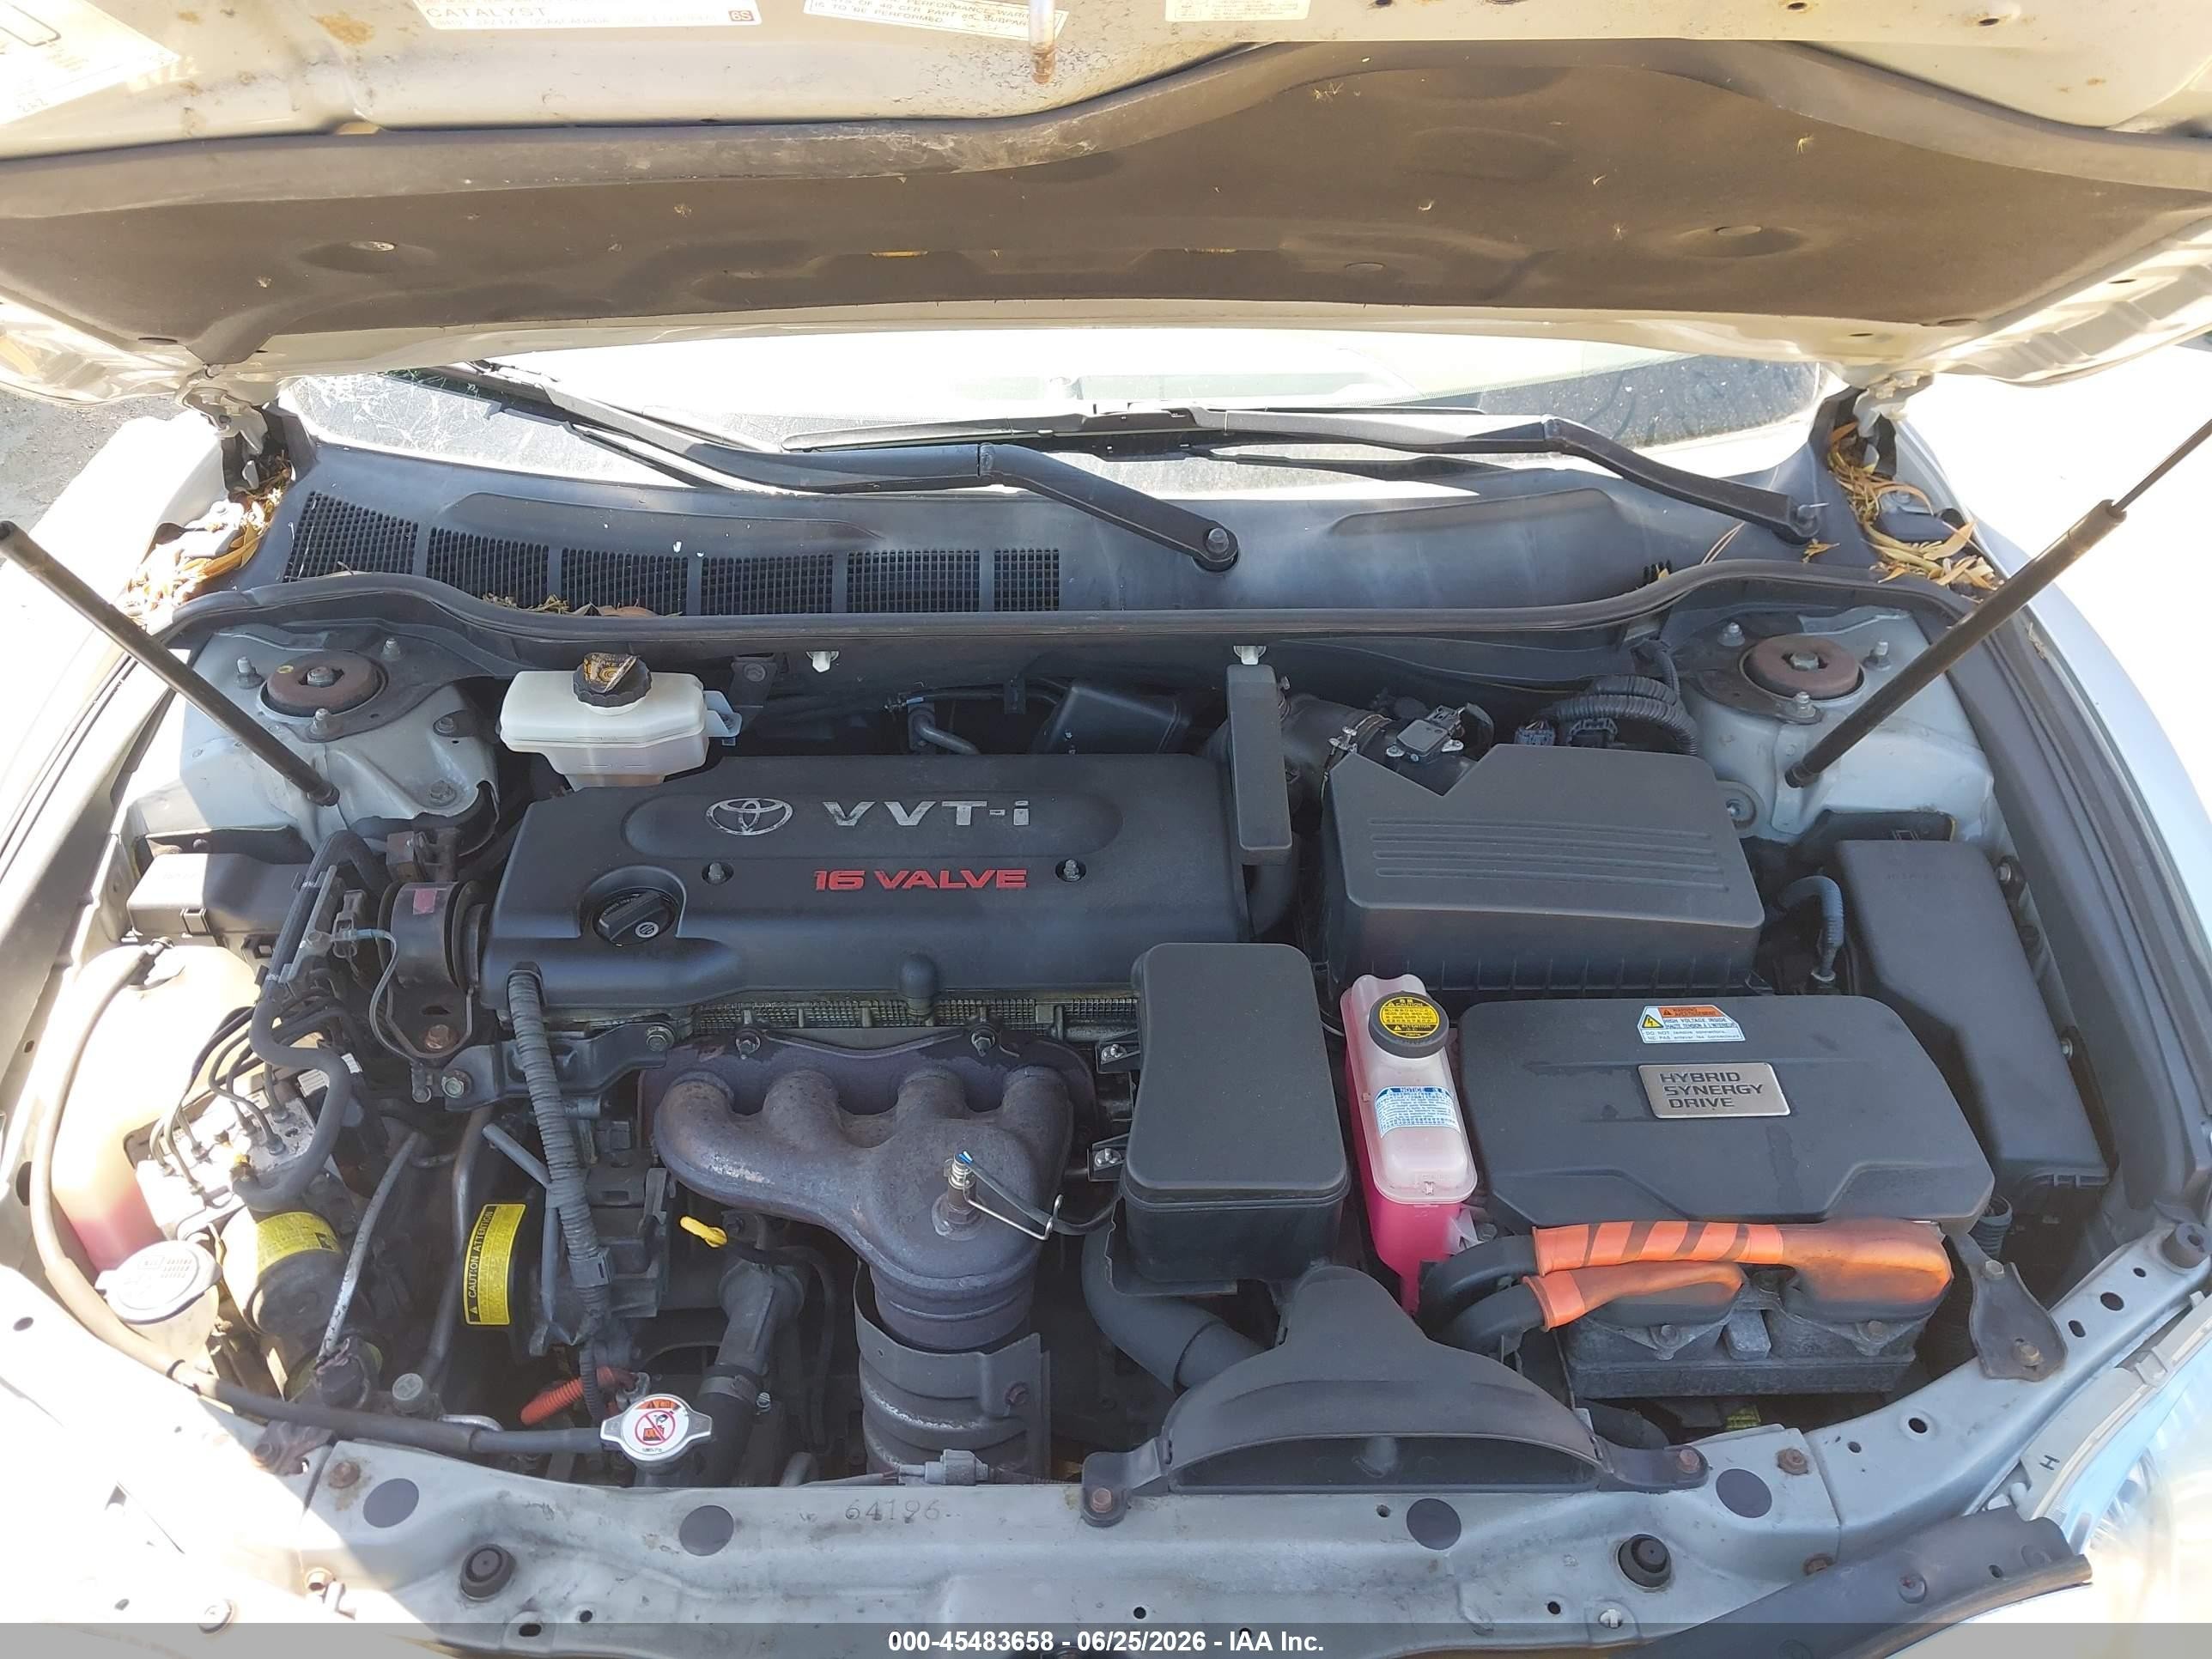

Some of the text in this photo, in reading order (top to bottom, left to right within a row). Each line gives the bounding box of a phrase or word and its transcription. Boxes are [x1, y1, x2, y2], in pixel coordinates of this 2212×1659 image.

[426, 8, 546, 18] CATALYST
[730, 10, 752, 21] 6S
[814, 869, 1029, 891] 16 VALVE
[1659, 1072, 1741, 1083] HYBRID
[1663, 1084, 1764, 1096] SYNERGY
[1668, 1097, 1735, 1109] DRIVE
[472, 1211, 494, 1252] ATTENTION
[467, 1255, 479, 1298] CAUTION
[845, 1498, 939, 1521] 64196
